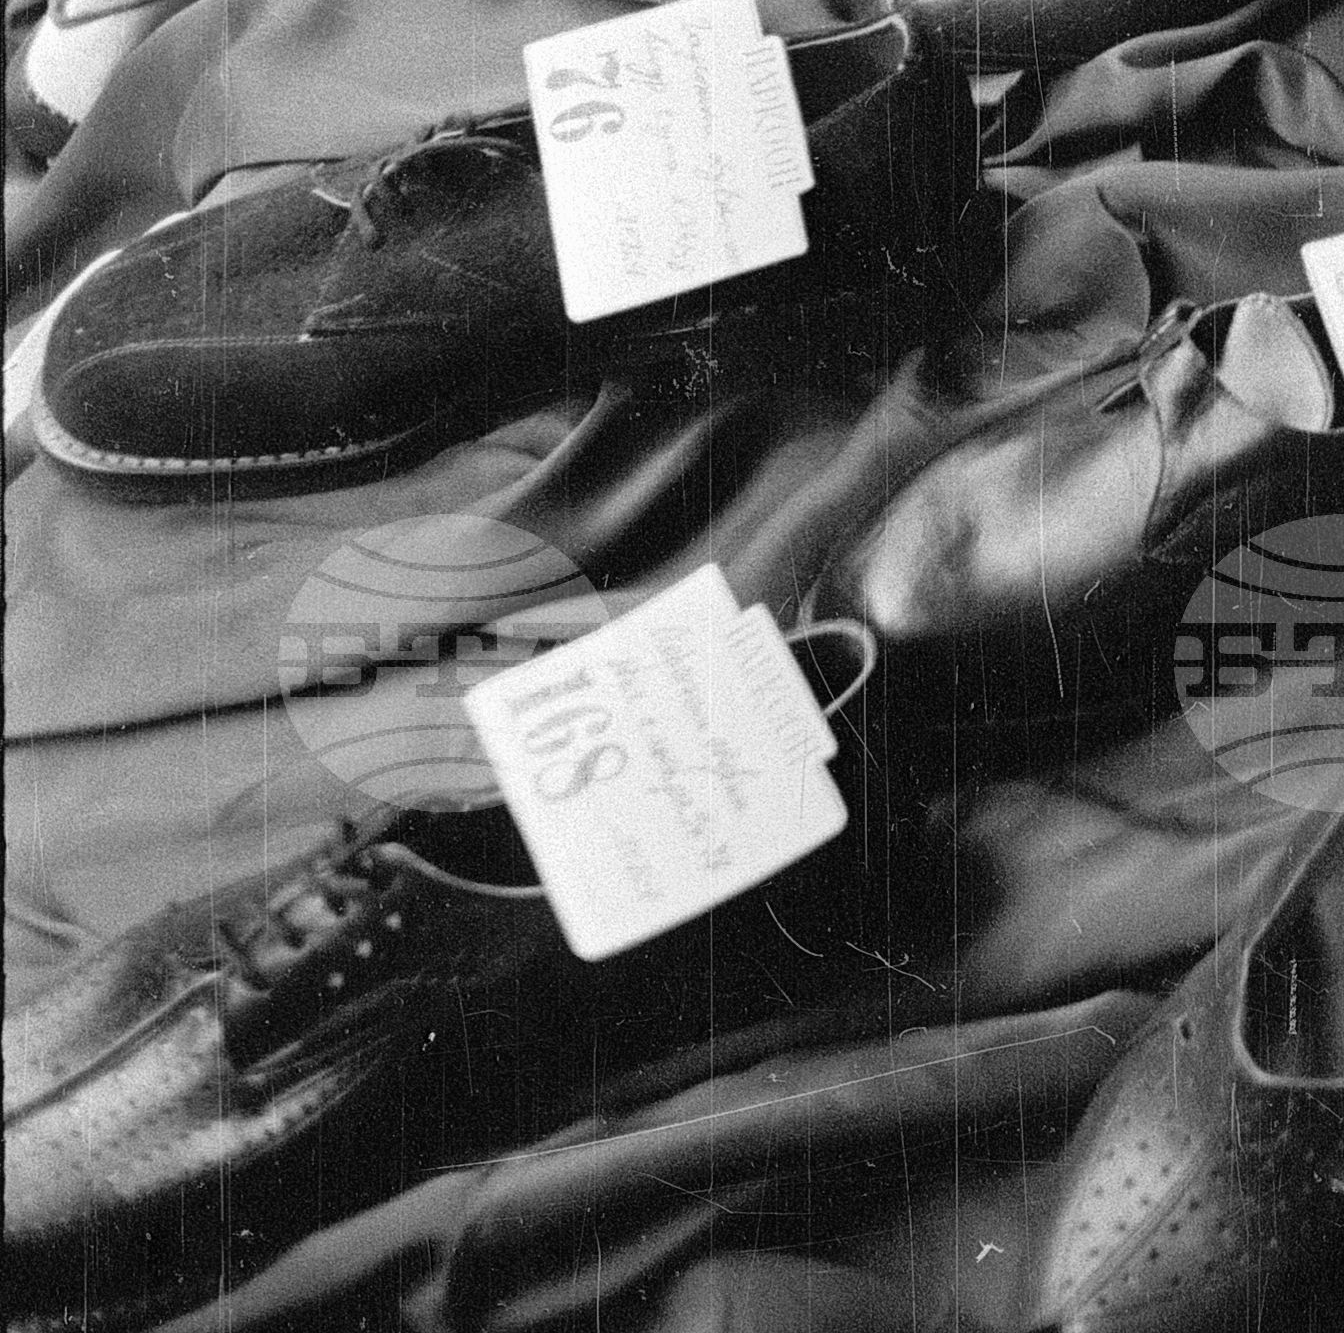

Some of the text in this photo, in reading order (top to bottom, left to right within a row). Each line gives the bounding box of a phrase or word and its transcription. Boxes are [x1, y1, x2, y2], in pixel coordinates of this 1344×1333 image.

[545, 49, 627, 143] 76
[742, 47, 802, 190] НАРКООП
[508, 666, 629, 804] 168
